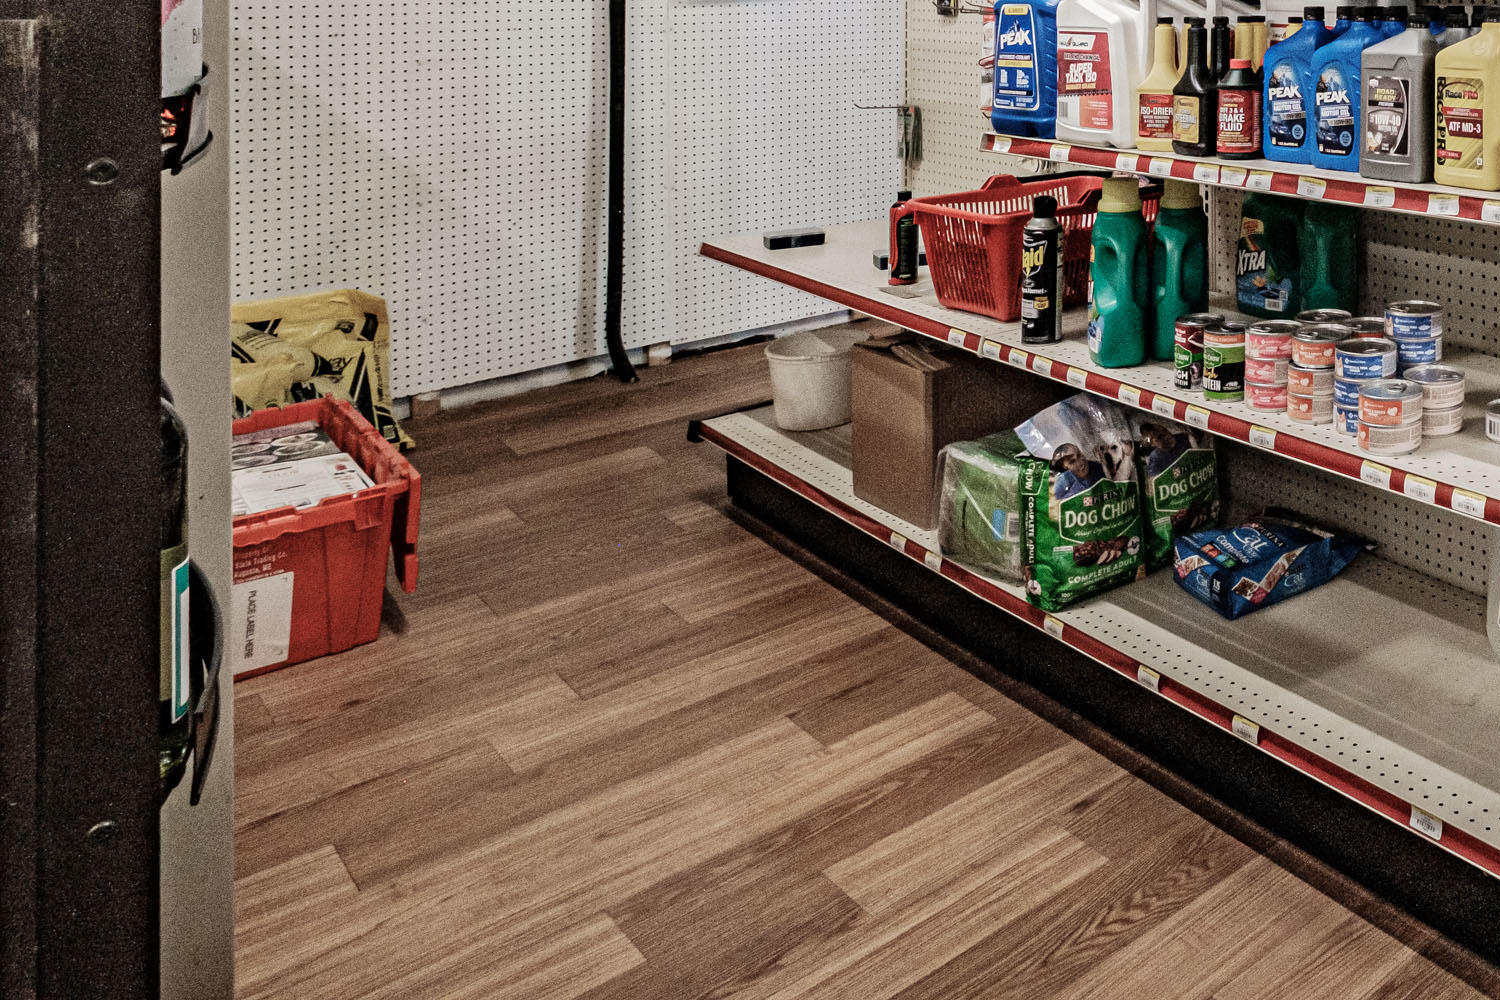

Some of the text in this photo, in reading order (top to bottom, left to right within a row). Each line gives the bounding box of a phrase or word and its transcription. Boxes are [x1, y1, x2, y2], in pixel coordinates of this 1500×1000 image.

[1000, 29, 1032, 50] PEAK
[1070, 62, 1093, 73] SUPER
[1066, 72, 1084, 84] TACK
[1268, 85, 1302, 101] PEAK
[1316, 89, 1350, 106] PEAK
[1445, 89, 1462, 99] Race
[1140, 107, 1173, 115] ISO-DRIER
[1220, 113, 1245, 123] BRAKE
[1220, 122, 1243, 131] FLUID
[1448, 121, 1481, 133] ATF MD-3
[1237, 249, 1266, 276] XTRA
[1024, 462, 1036, 491] CHOW
[1158, 482, 1188, 500] DOG
[1064, 495, 1135, 529] DOG CHOW
[1027, 496, 1036, 564] COMPLETE ADULT
[1216, 535, 1249, 564] Complete
[1068, 555, 1137, 584] COMPLETE ADULT
[244, 590, 257, 660] PLACE LABEL HERE
